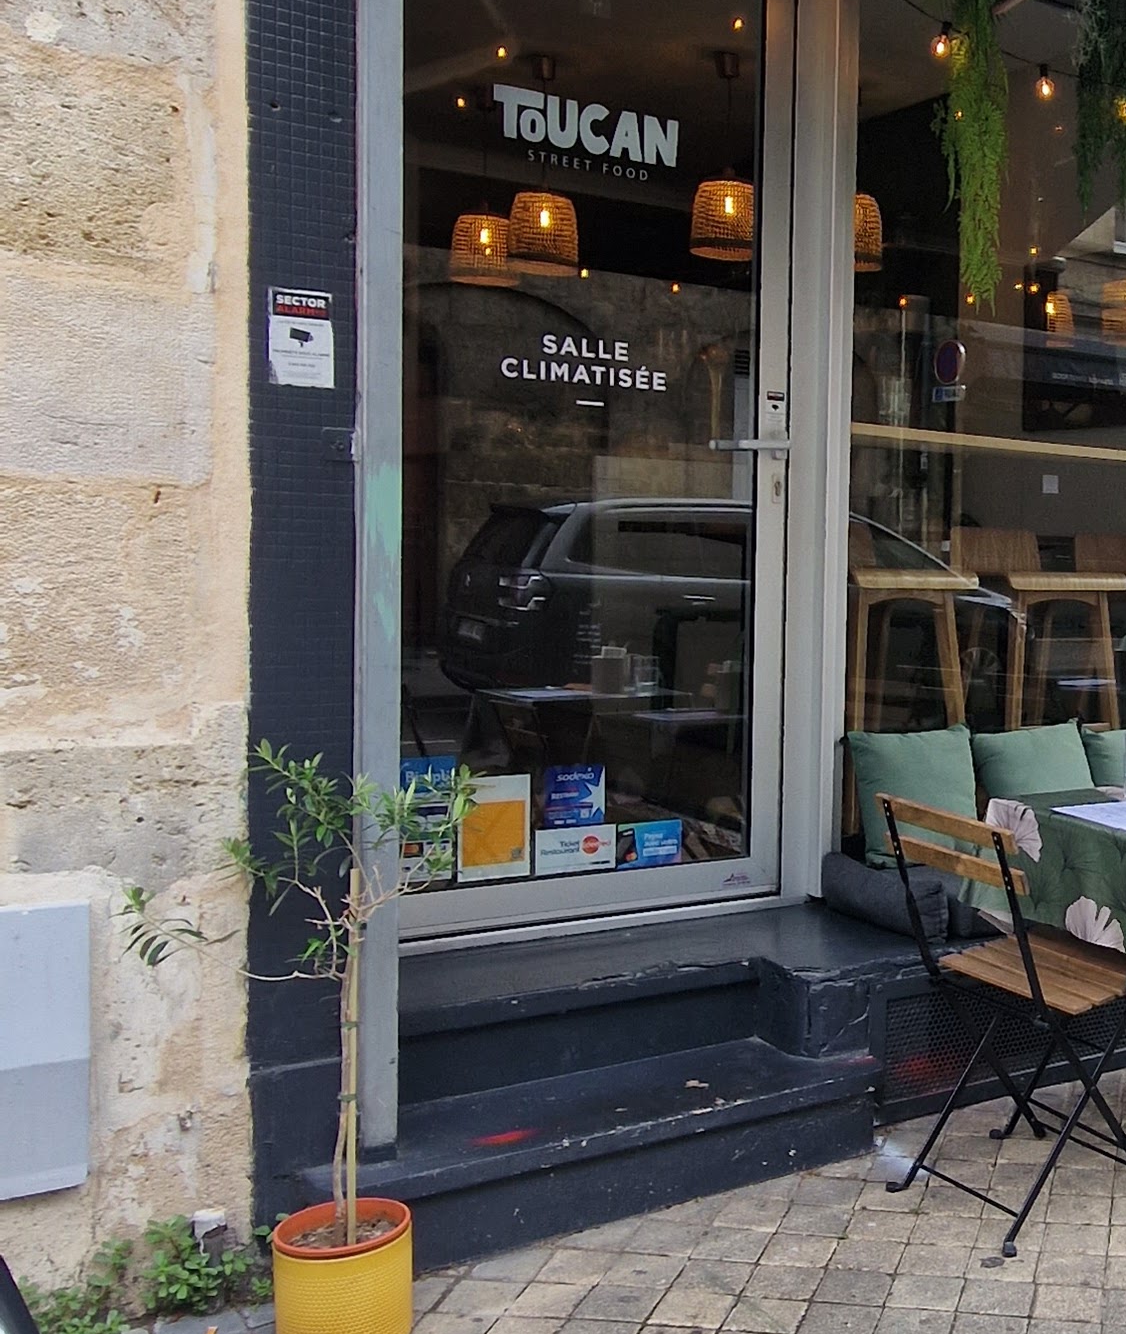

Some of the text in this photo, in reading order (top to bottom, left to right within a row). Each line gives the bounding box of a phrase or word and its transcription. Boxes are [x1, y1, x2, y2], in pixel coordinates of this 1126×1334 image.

[528, 149, 649, 181] STREET FOOD
[276, 294, 326, 308] SECTOR
[543, 335, 629, 362] SALLE
[501, 358, 667, 391] CLIMATISÉE
